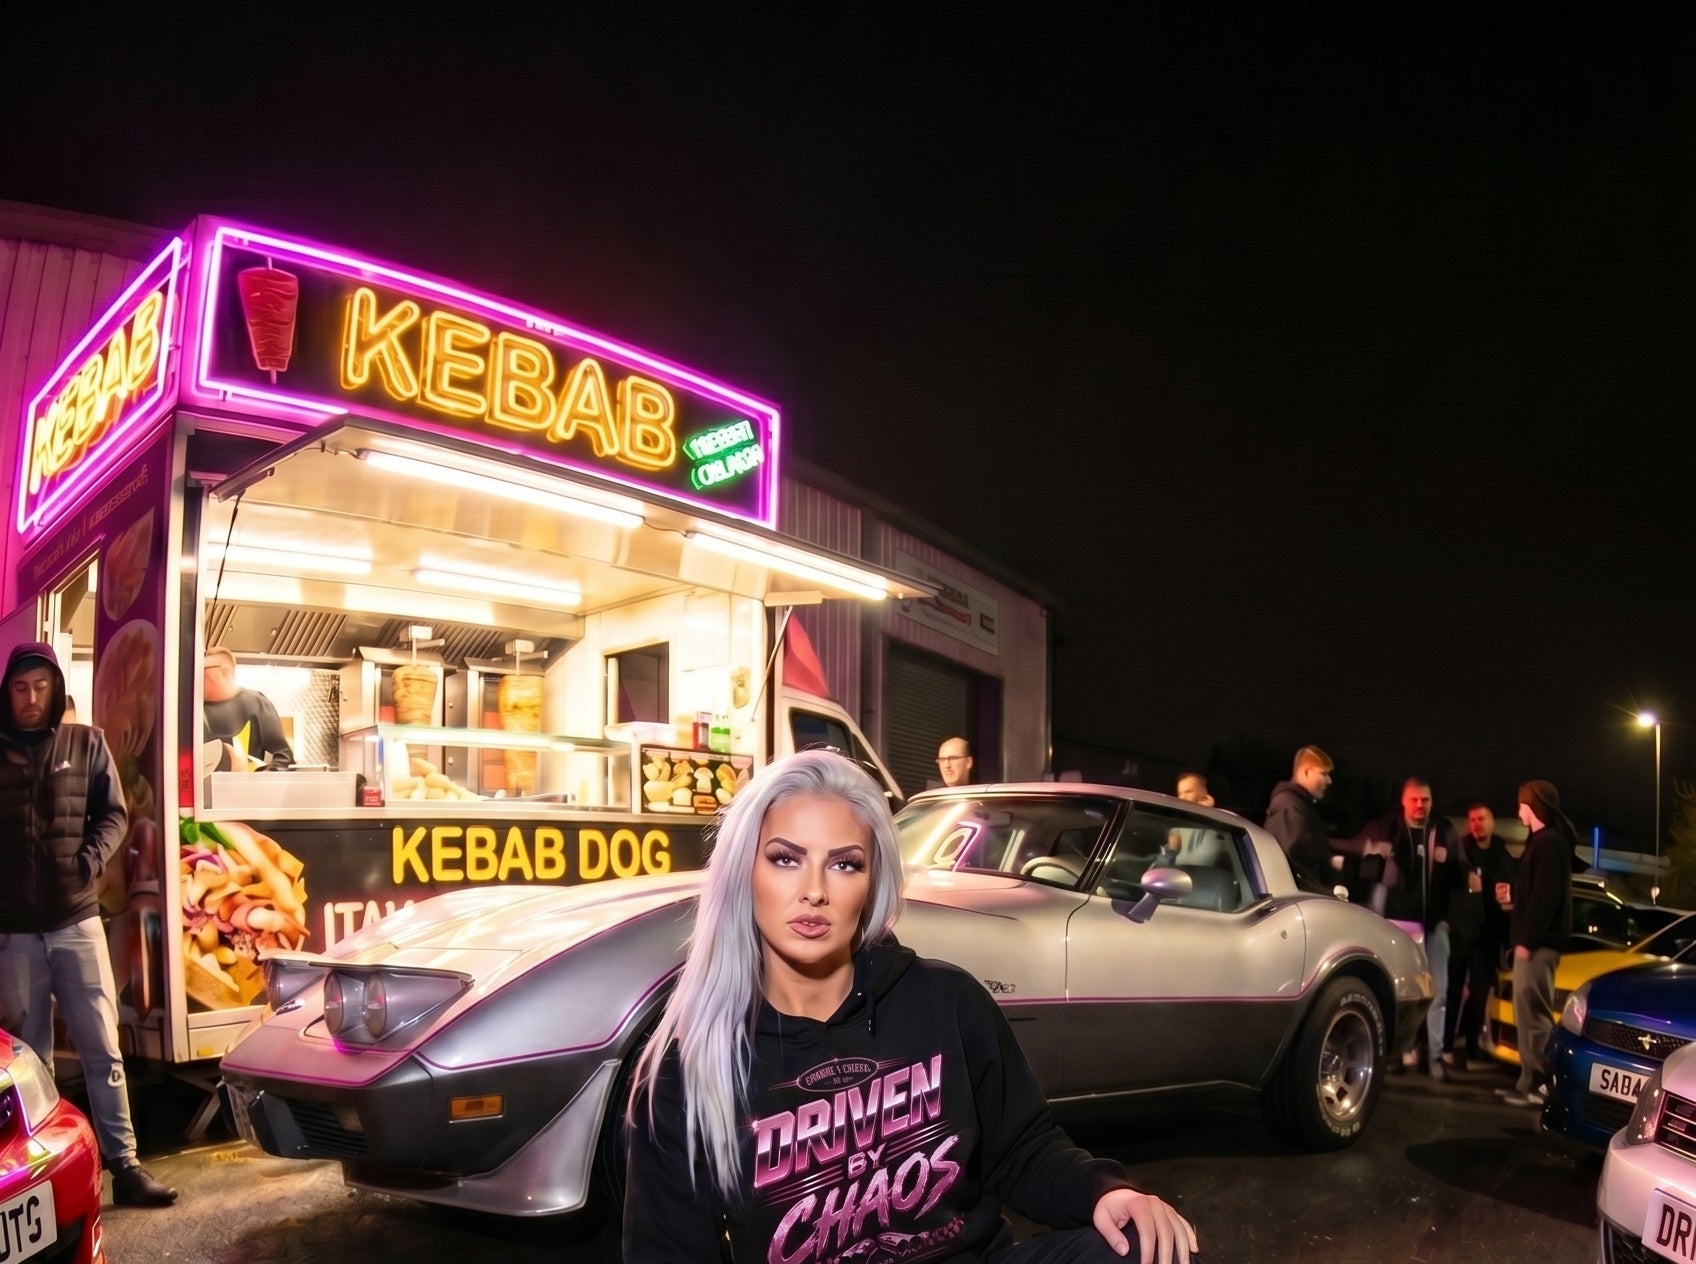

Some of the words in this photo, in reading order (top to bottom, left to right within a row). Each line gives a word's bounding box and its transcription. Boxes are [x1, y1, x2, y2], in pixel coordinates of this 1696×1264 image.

[29, 290, 163, 495] KEBAB
[341, 287, 677, 470] KEBAB
[392, 825, 567, 885] KEBAB
[578, 828, 672, 881] DOG
[753, 1053, 943, 1189] DRIVEN
[847, 1142, 888, 1180] BY
